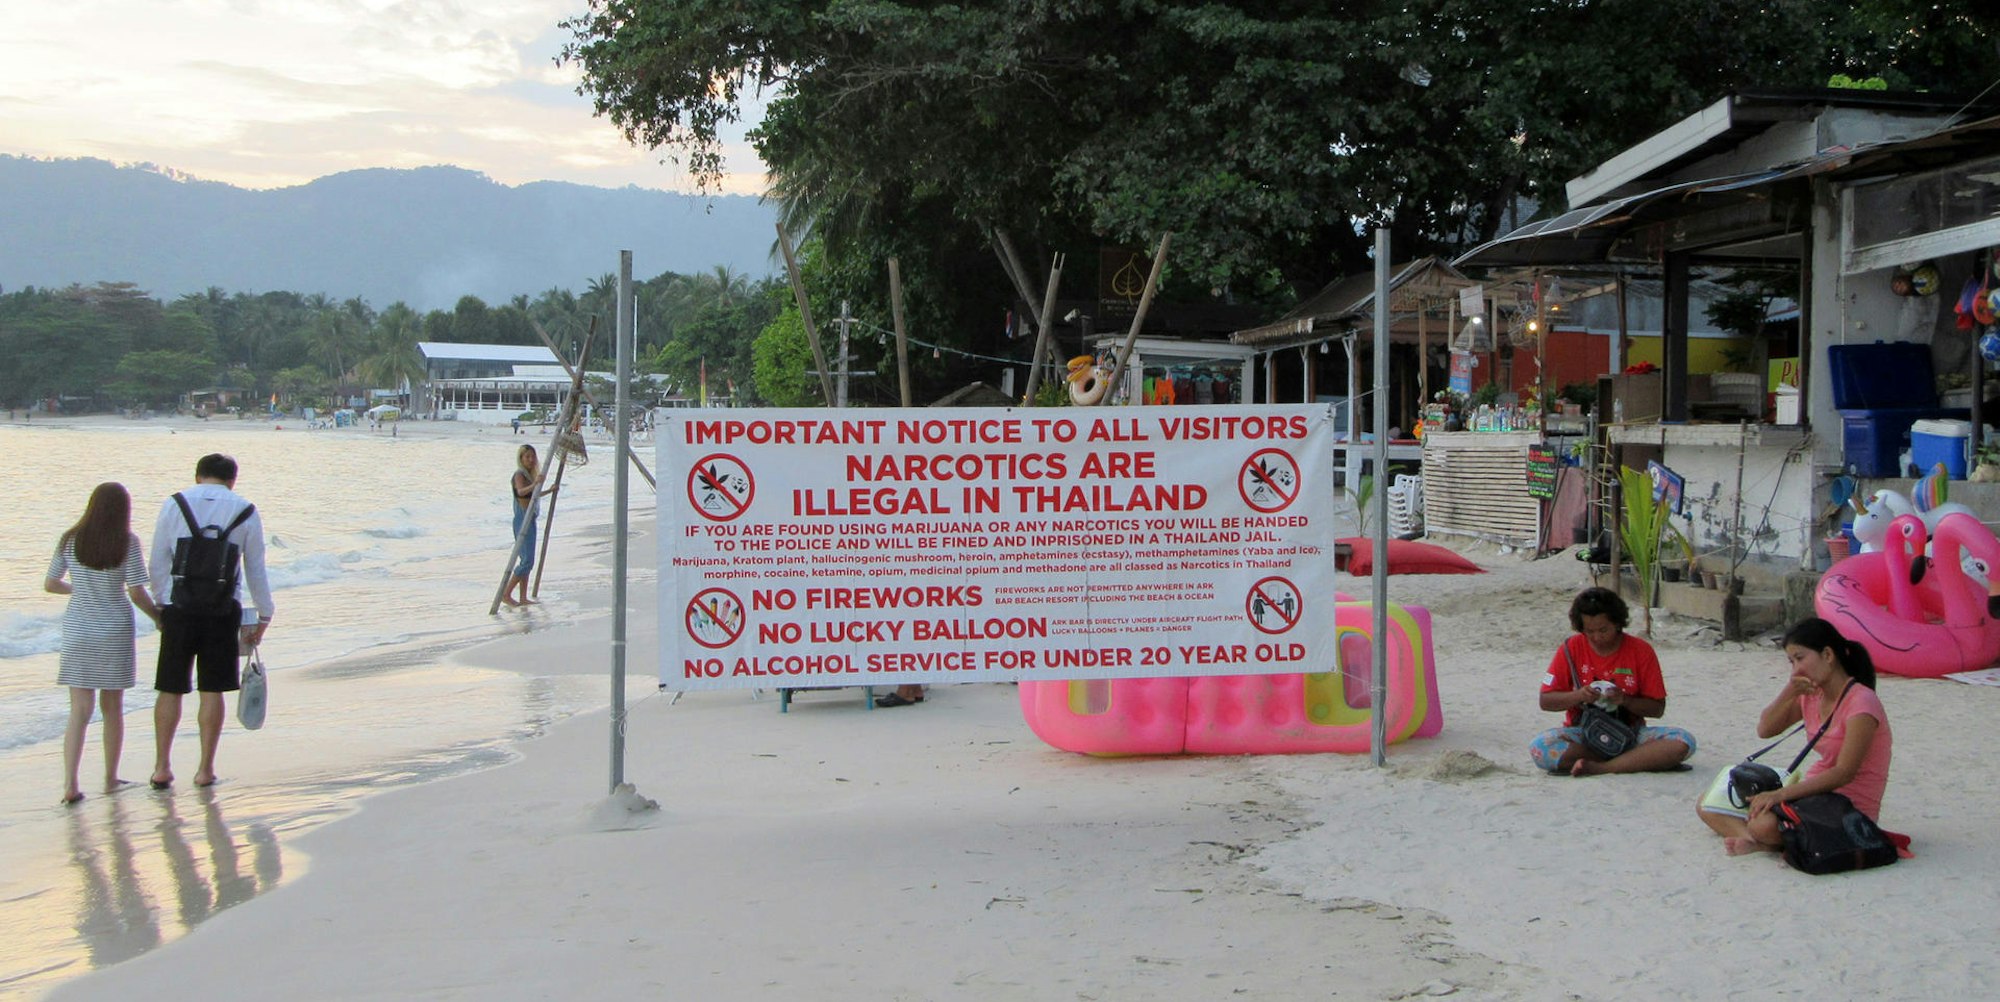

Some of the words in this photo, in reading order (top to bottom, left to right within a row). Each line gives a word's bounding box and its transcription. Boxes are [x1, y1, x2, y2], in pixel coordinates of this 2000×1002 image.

[685, 421, 886, 444] IMPORTANT
[898, 420, 1021, 444] NOTICE
[1032, 420, 1076, 443] TO
[1088, 419, 1148, 442] ALL
[1160, 416, 1307, 440] VISITORS
[846, 453, 1074, 481] NARCOTICS
[1079, 452, 1155, 478] ARE
[794, 488, 950, 516] ILLEGAL
[963, 487, 1002, 513] IN
[1013, 485, 1207, 512] THAILAND
[686, 526, 700, 536] IF
[704, 524, 738, 536] YOU
[742, 524, 772, 536] ARE
[779, 524, 835, 536] FOUND
[840, 524, 887, 535] USING
[892, 522, 983, 534] MARIJUANA
[989, 521, 1010, 532] OR
[1016, 522, 1046, 532] ANY
[1052, 520, 1140, 531] NARCOTICS
[1145, 520, 1175, 530] YOU
[1180, 518, 1216, 529] WILL
[1222, 518, 1240, 528] BE
[1244, 516, 1308, 528] HANDED
[716, 540, 736, 551] TO
[740, 540, 771, 550] THE
[776, 539, 833, 550] POLICE
[837, 539, 870, 549] AND
[876, 538, 912, 549] WILL
[918, 538, 937, 548] BE
[942, 537, 988, 548] FINED
[994, 536, 1026, 546] AND
[1032, 534, 1124, 546] INPRISONED
[1130, 534, 1144, 544] IN
[1149, 534, 1159, 544] A
[1165, 531, 1241, 543] THAILAND
[1246, 532, 1282, 542] JAIL.
[672, 558, 730, 567] Marijuana,
[733, 556, 774, 564] Kratom
[776, 556, 809, 565] plant,
[812, 555, 891, 565] hallucinogenic
[894, 554, 956, 564] mushroom,
[958, 554, 997, 562] heroin,
[1000, 552, 1078, 561] amphetamines
[1082, 550, 1132, 560] (ecstasy),
[1136, 549, 1240, 558] methamphetamines
[1299, 546, 1321, 556] Ice),
[704, 570, 760, 579] morphine,
[812, 568, 866, 577] ketamine,
[869, 569, 906, 577] opium,
[910, 566, 962, 575] medicinal
[966, 566, 1000, 576] opium
[1003, 566, 1023, 574] and
[1247, 560, 1292, 568] Thailand
[754, 589, 796, 610] NO
[807, 586, 982, 608] FIREWORKS
[760, 623, 802, 644] NO
[811, 620, 904, 643] LUCKY
[913, 617, 1047, 640] BALLOON
[685, 659, 724, 678] NO
[733, 655, 859, 676] ALCOHOL
[867, 652, 976, 672] SERVICE
[985, 651, 1036, 669] FOR
[1044, 648, 1132, 668] UNDER
[1140, 647, 1171, 665] 20
[1179, 645, 1247, 664] YEAR
[1255, 643, 1306, 662] OLD
